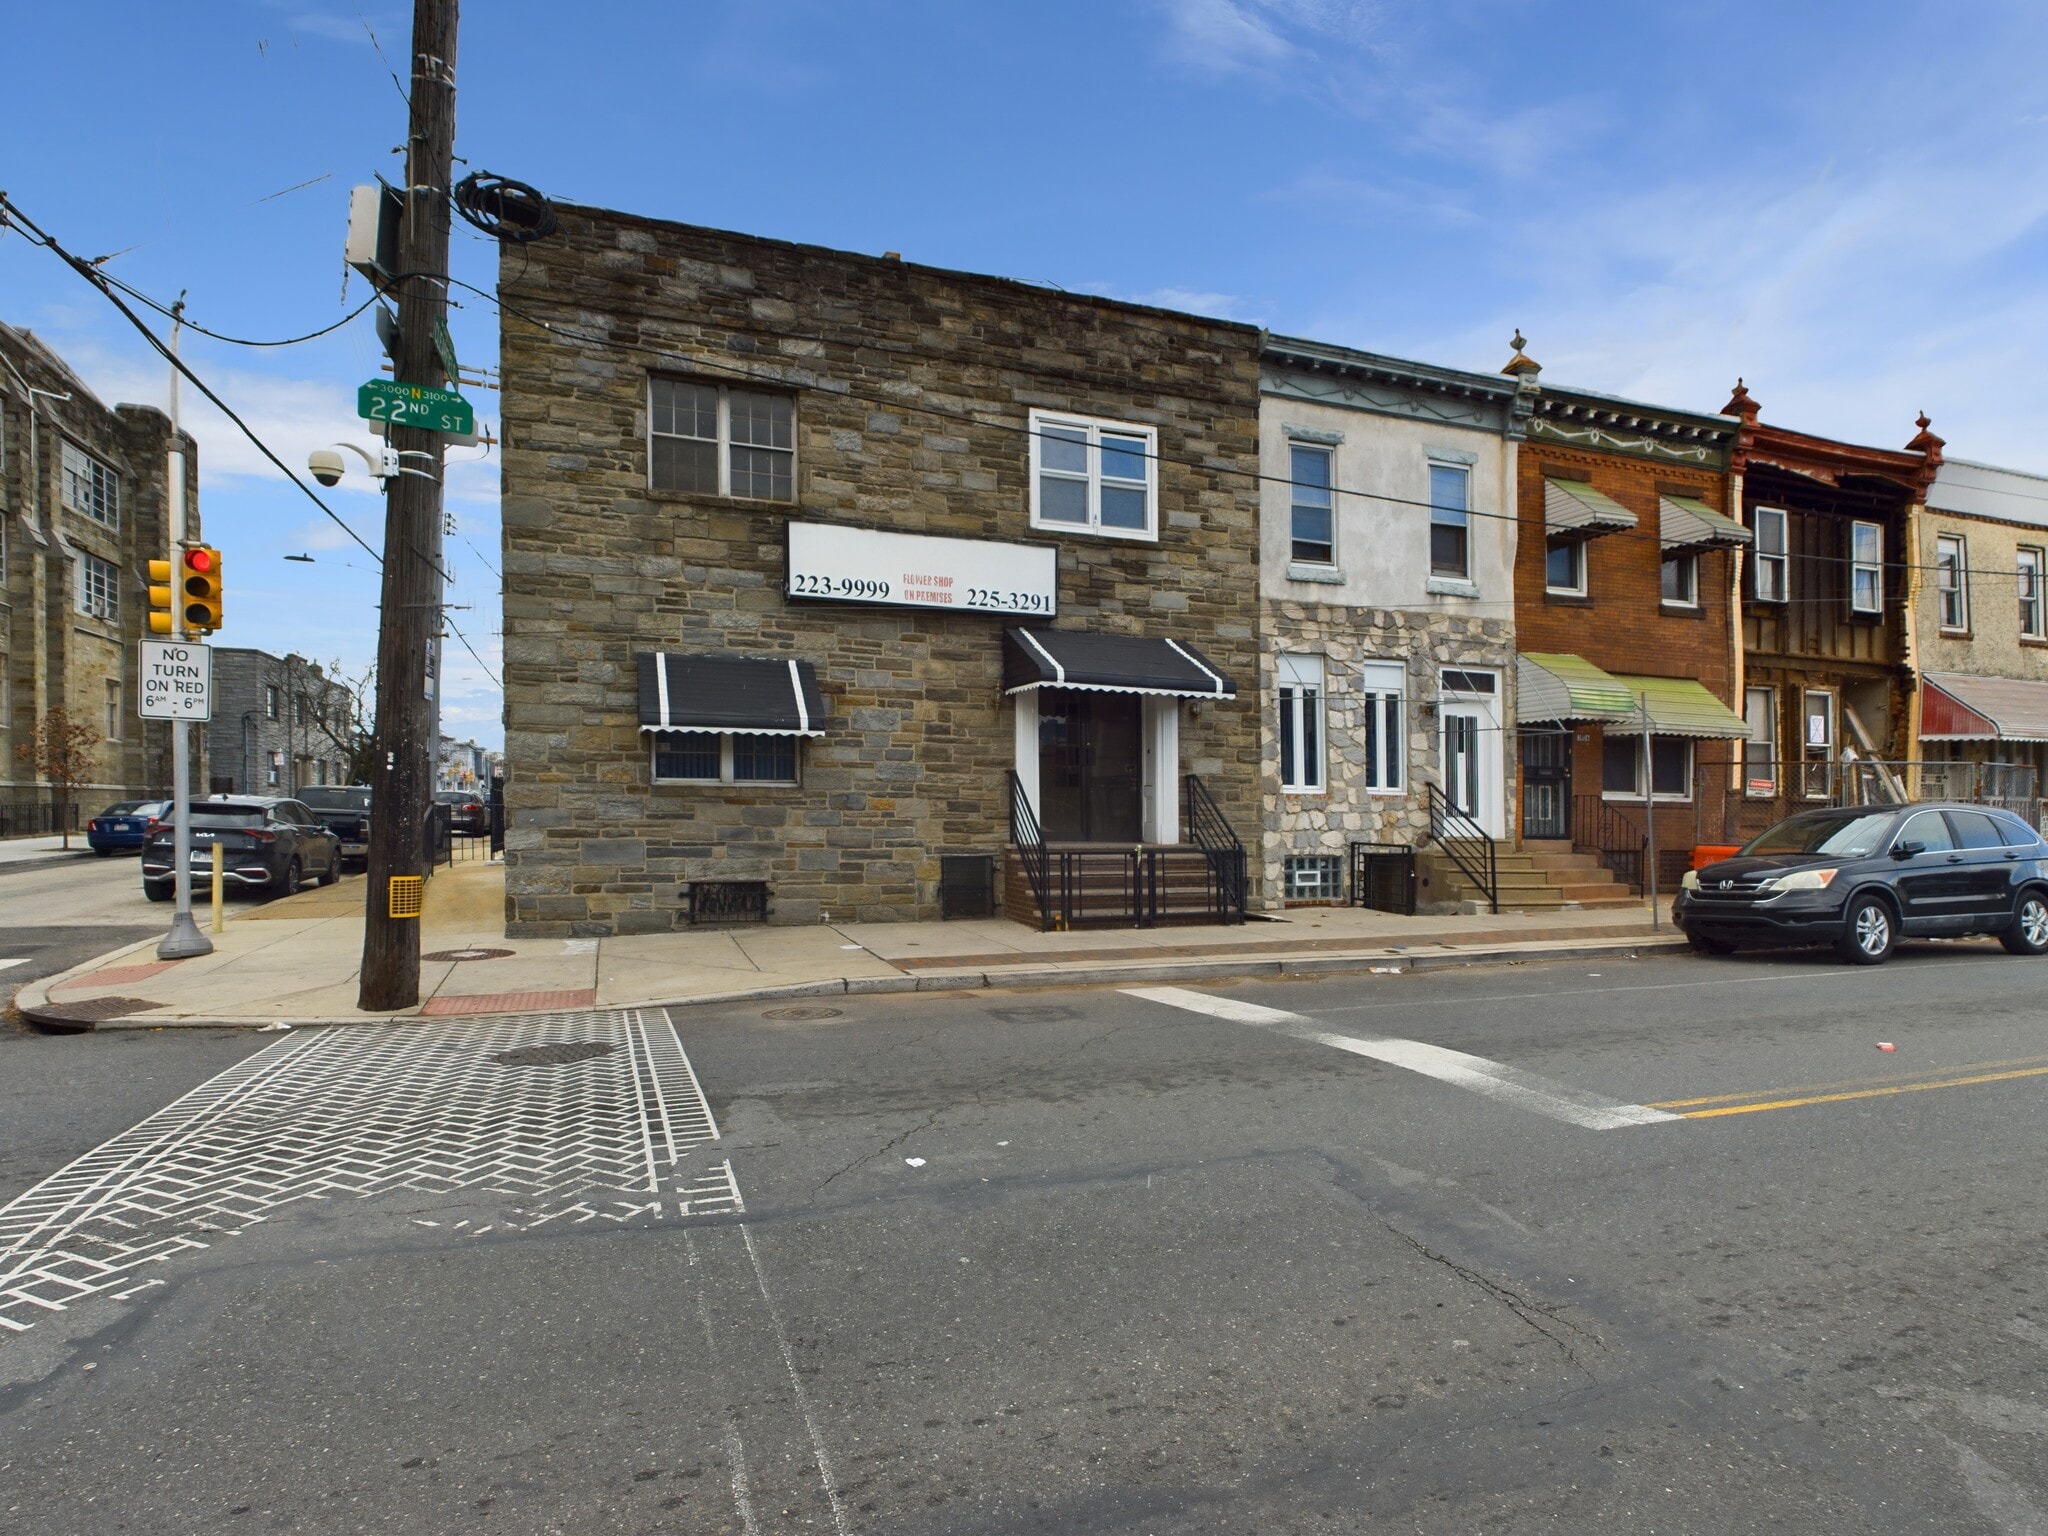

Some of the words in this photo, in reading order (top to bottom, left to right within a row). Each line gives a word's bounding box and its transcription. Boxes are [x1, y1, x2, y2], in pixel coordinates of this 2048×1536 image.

[380, 384, 410, 395] 3000
[411, 387, 421, 399] N
[423, 391, 448, 402] 3100
[441, 414, 463, 431] ST
[794, 574, 890, 599] 223-9999
[903, 573, 932, 586] FLOWER
[934, 576, 953, 588] SHOP
[904, 589, 915, 601] ON
[916, 590, 953, 604] PREMISES
[966, 588, 1051, 612] 225-3291
[163, 649, 188, 661] NO
[152, 664, 199, 678] TURN
[146, 680, 169, 692] ON
[175, 681, 204, 694] RED
